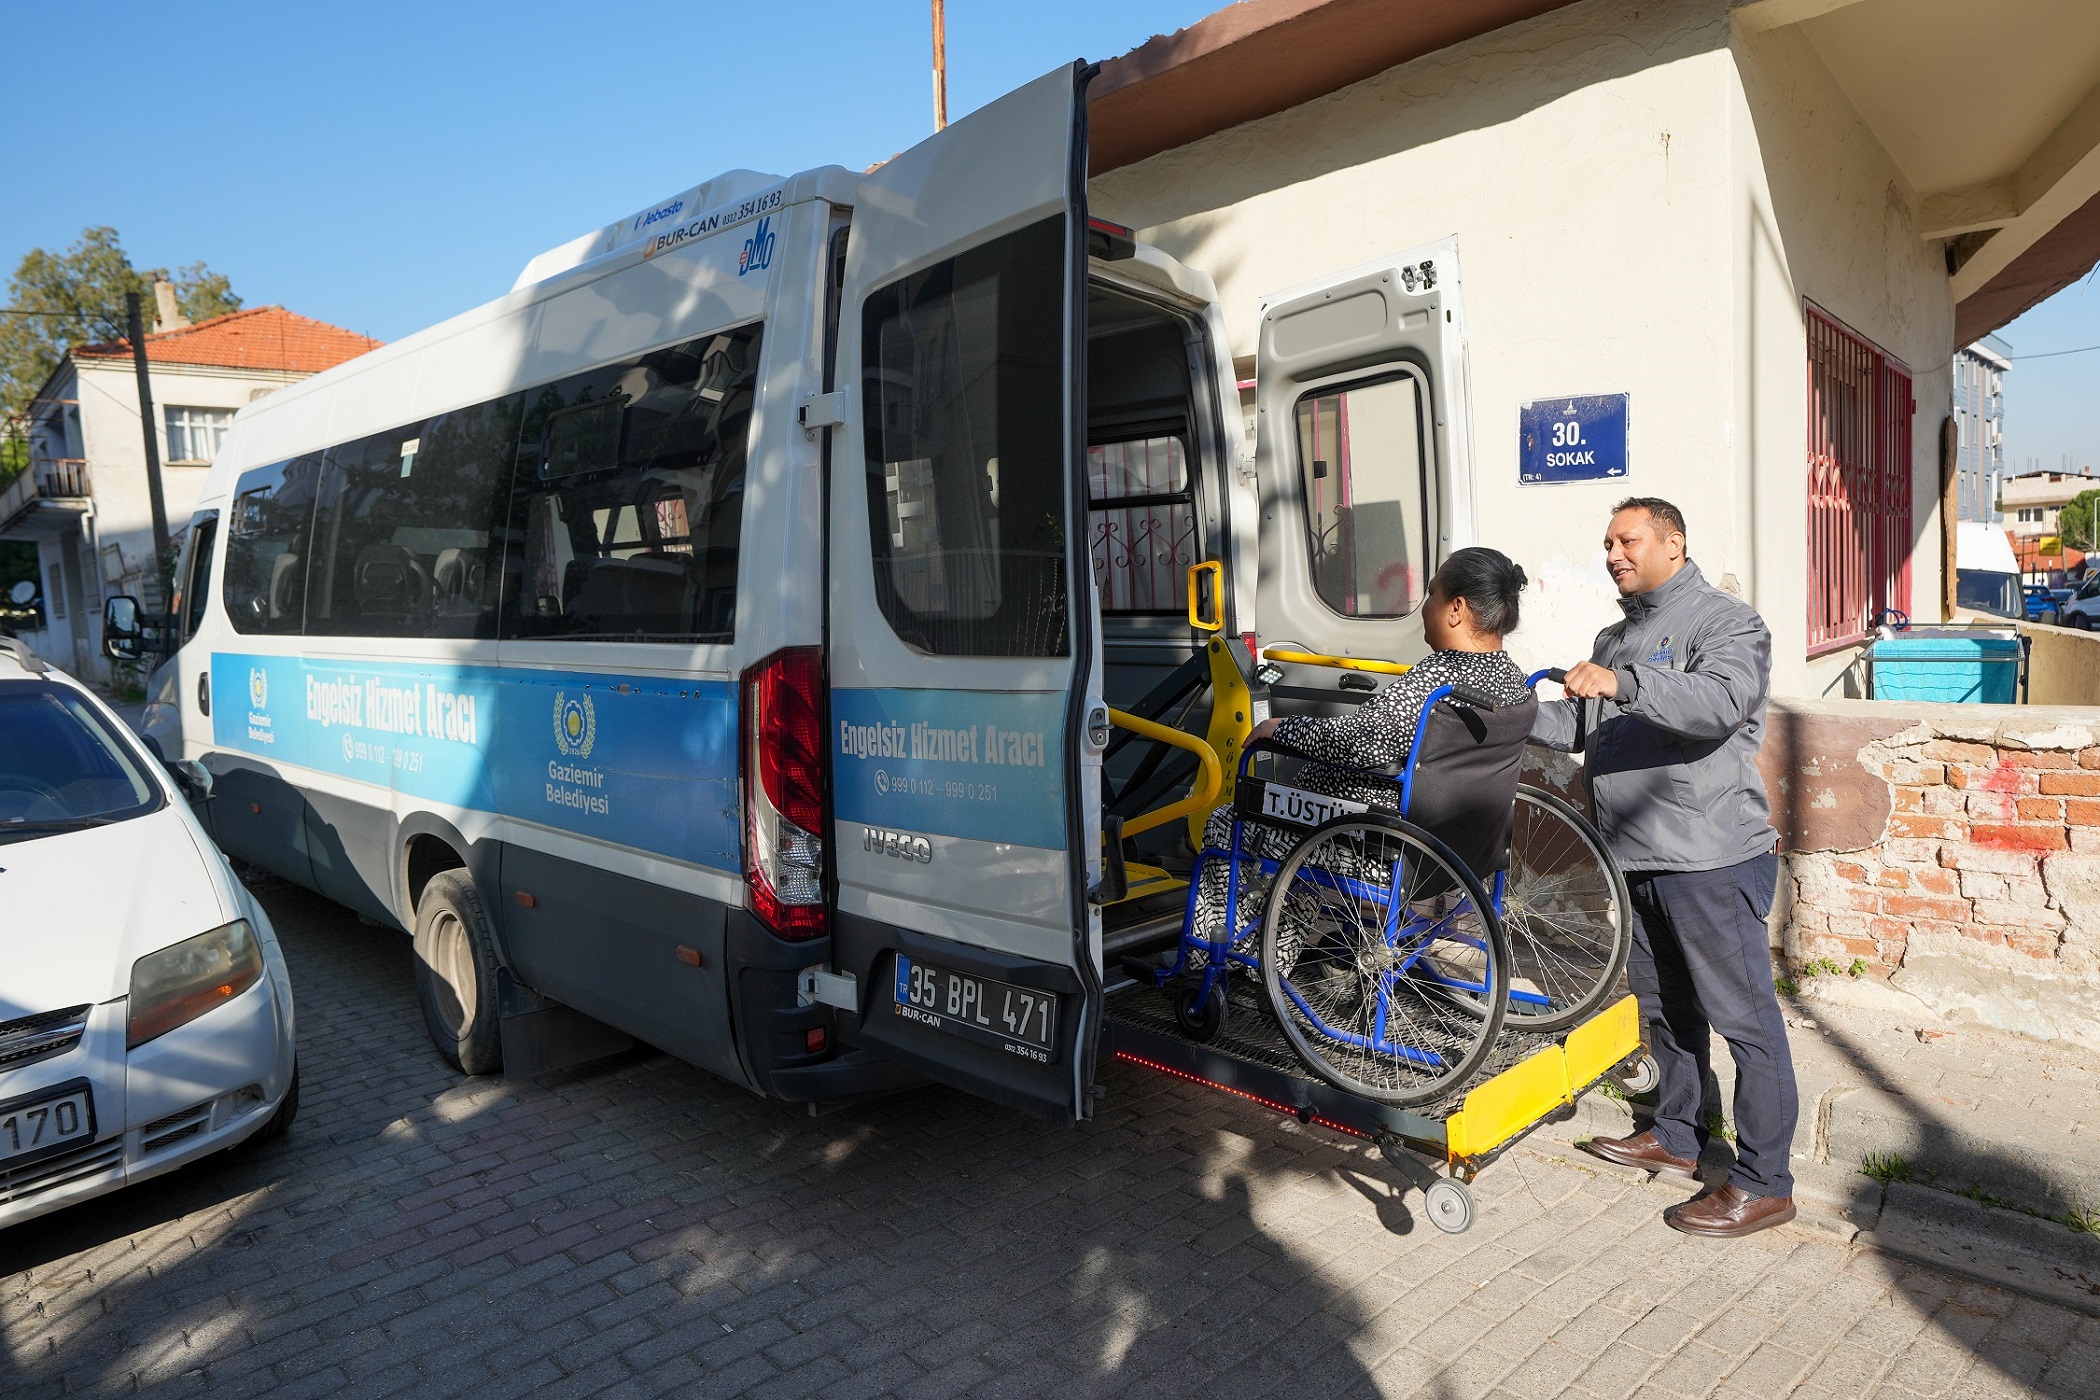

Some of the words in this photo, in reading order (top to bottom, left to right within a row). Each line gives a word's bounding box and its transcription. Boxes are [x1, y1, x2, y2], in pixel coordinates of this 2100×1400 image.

[657, 214, 719, 250] BUR-CAN
[722, 212, 738, 226] 0312
[738, 203, 755, 220] 354
[756, 195, 769, 214] 16
[769, 190, 781, 208] 93
[1552, 421, 1587, 447] 30.
[1546, 451, 1595, 467] SOKAK
[306, 674, 363, 728] Engelsiz
[366, 676, 423, 737] Hizmet
[426, 683, 477, 745] Aracı
[840, 720, 907, 760] Engelsiz
[911, 721, 979, 764] Hizmet
[985, 725, 1045, 767] Aracı
[409, 751, 423, 772] 251
[548, 760, 604, 788] Gaziemir
[546, 783, 609, 815] Belediyesi
[891, 776, 908, 793] 999
[910, 778, 917, 794] 0
[919, 779, 934, 796] 112
[945, 781, 965, 799] 999
[968, 783, 975, 799] 0
[978, 784, 997, 801] 251
[1268, 792, 1352, 824] T.ÜSTÜ
[863, 828, 932, 864] IVECO
[899, 982, 908, 995] TR
[909, 965, 937, 1008] 35
[947, 974, 990, 1026] BPL
[1003, 990, 1048, 1043] 471
[902, 1007, 941, 1028] BUR-CAN
[1016, 1045, 1029, 1057] 354
[1030, 1049, 1038, 1060] 16
[1038, 1052, 1047, 1063] 93
[3, 1100, 79, 1151] 170
